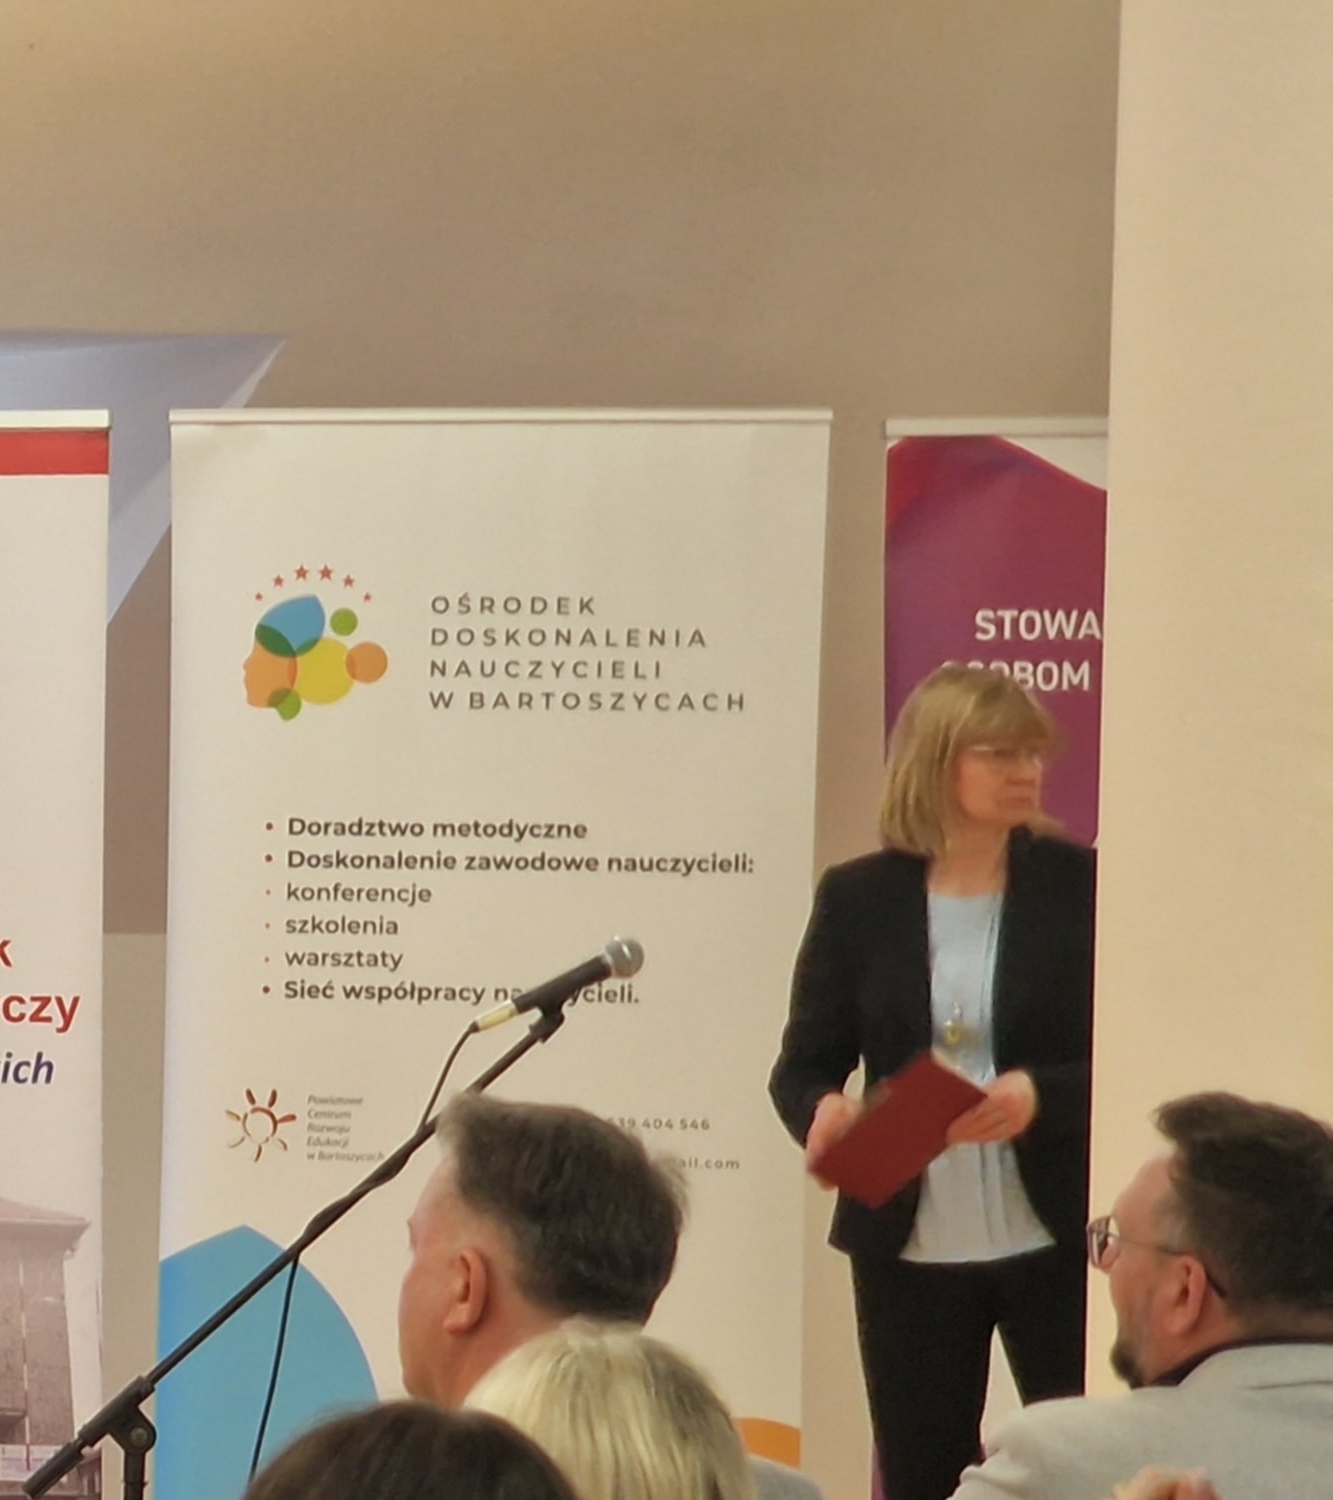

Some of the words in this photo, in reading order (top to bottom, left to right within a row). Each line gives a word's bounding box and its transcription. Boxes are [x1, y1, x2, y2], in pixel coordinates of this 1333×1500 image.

[431, 592, 597, 616] OŚRODEK
[974, 608, 1102, 641] STOWA
[431, 628, 708, 648] DOSKONALENIA
[430, 660, 662, 680] NAUCZYCIELI
[429, 692, 454, 711] W
[469, 692, 746, 713] BARTOSZYCACH
[287, 817, 425, 838] Doradztwo
[432, 819, 588, 842] metodyczne
[287, 850, 457, 871] Doskonalenie
[464, 853, 599, 873] zawodowe
[607, 853, 755, 876] nauczycieli:
[286, 883, 432, 907] konferencje
[285, 916, 399, 936] szkolenia
[284, 949, 404, 972] warsztaty
[283, 980, 334, 1000] Sieć
[342, 980, 486, 1006] współpracy
[642, 1117, 674, 1130] 404
